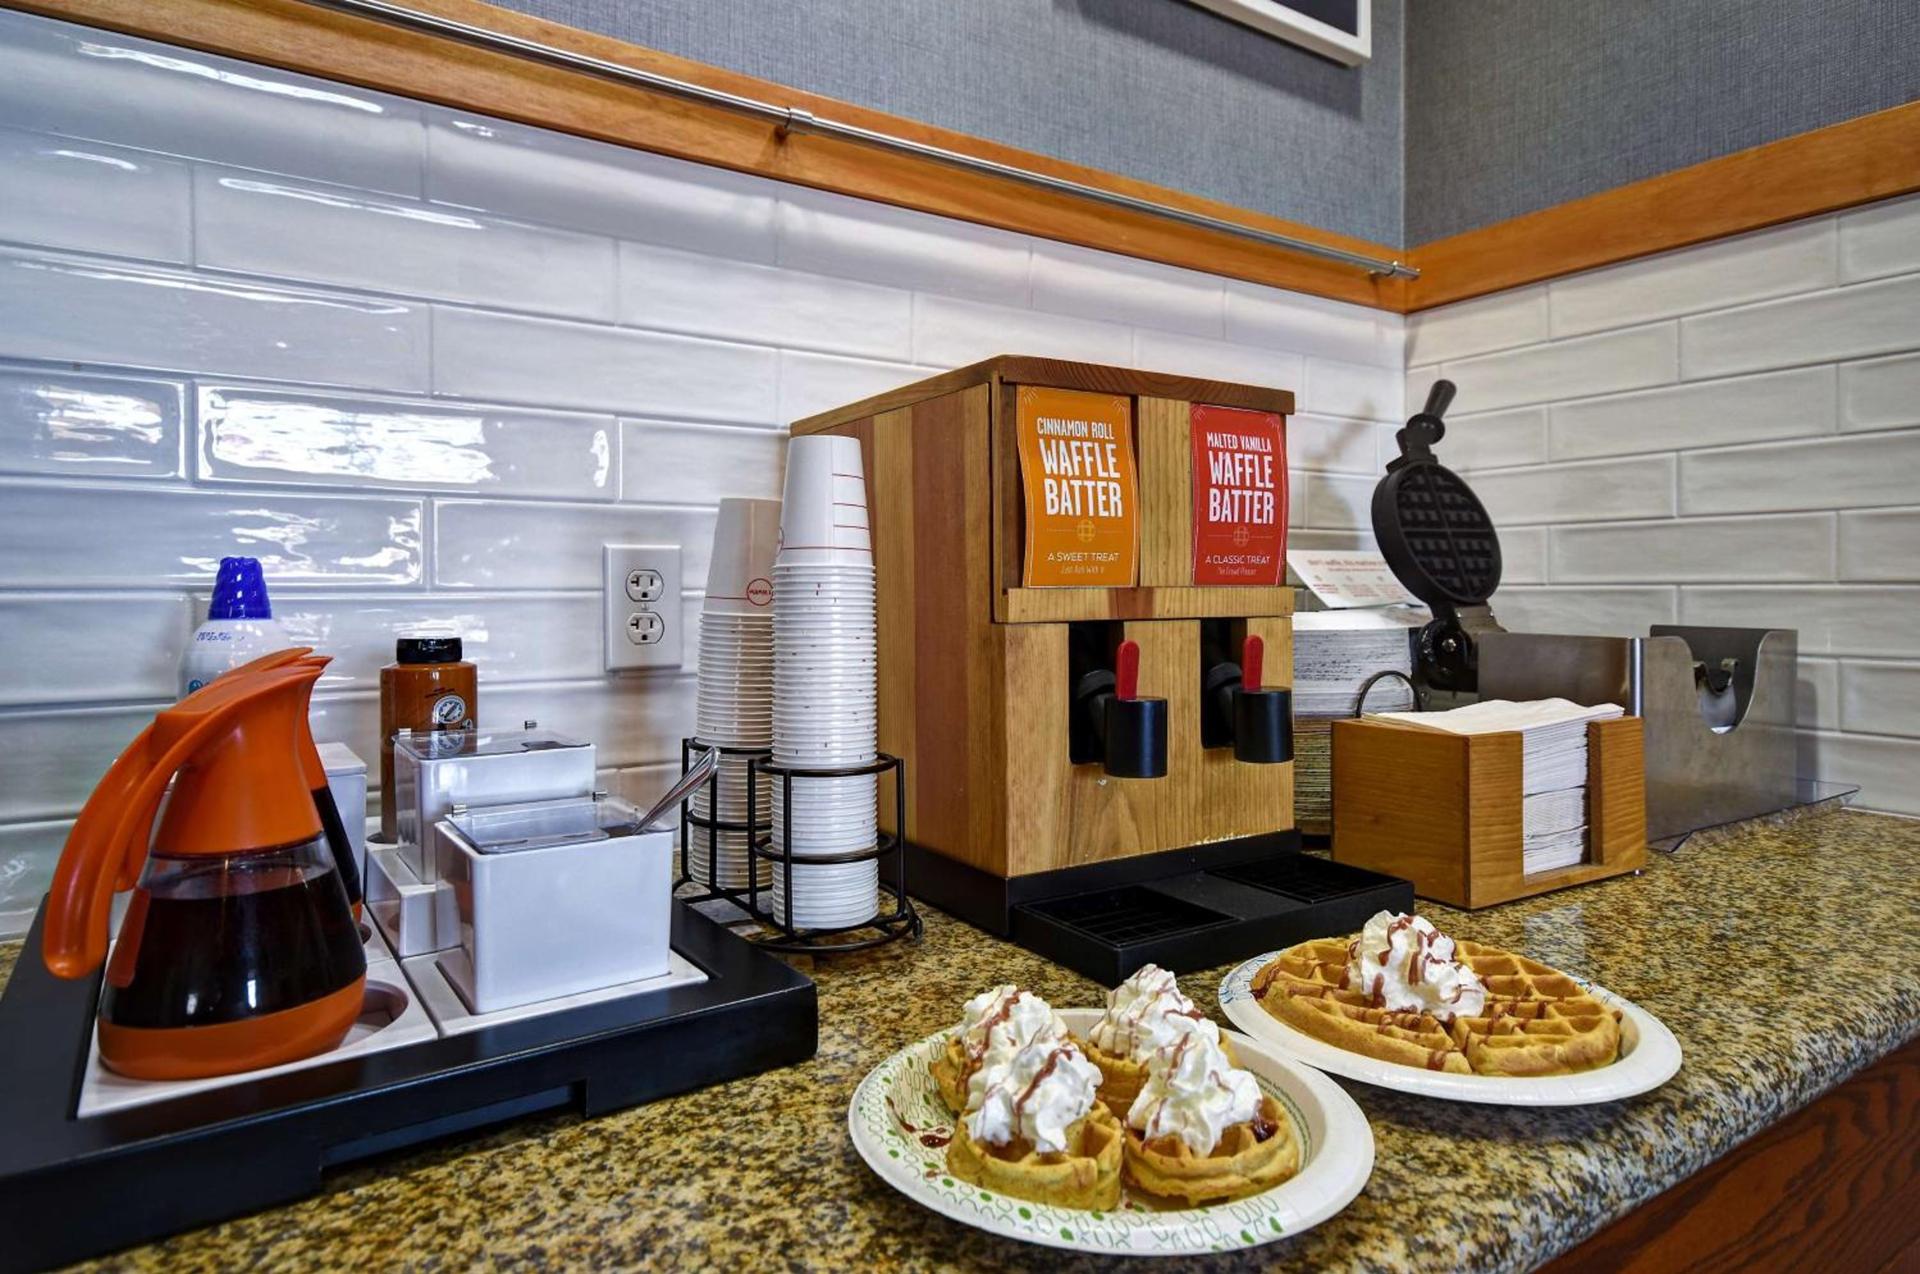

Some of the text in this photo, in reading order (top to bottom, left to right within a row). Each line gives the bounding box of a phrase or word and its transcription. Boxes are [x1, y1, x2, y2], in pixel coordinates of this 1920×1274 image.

[1037, 417, 1115, 440] CINNAMON ROLL
[1206, 432, 1272, 453] MALTED VANILLA
[1039, 438, 1120, 479] WAFFLE
[1208, 450, 1274, 489] WAFFLE
[1045, 478, 1123, 518] BATTER
[1209, 488, 1274, 525] BATTER
[1047, 552, 1120, 562] A SWEET TREAT
[1205, 555, 1270, 565] A CLASSIC TREAT
